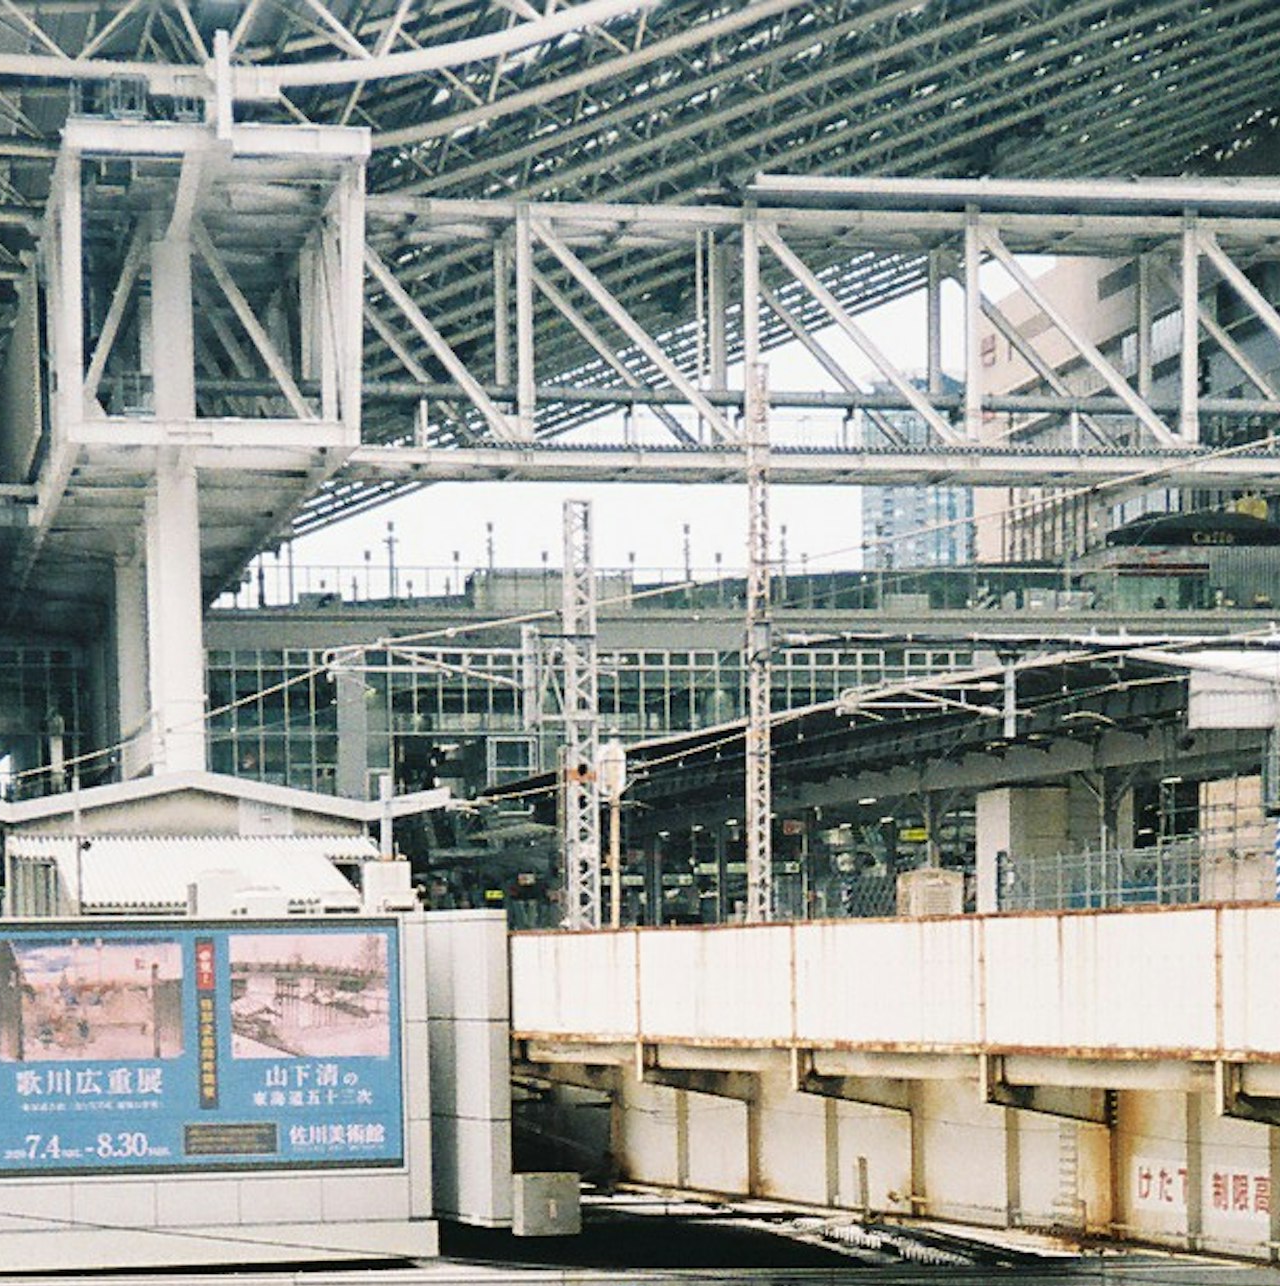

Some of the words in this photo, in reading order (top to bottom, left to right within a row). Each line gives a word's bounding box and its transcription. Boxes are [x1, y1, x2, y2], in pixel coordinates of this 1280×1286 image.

[15, 1067, 163, 1096] 歌川広重展
[264, 1063, 359, 1088] 山下清の
[252, 1089, 374, 1107] 東海道五十三次
[288, 1123, 386, 1145] 佐川美術館
